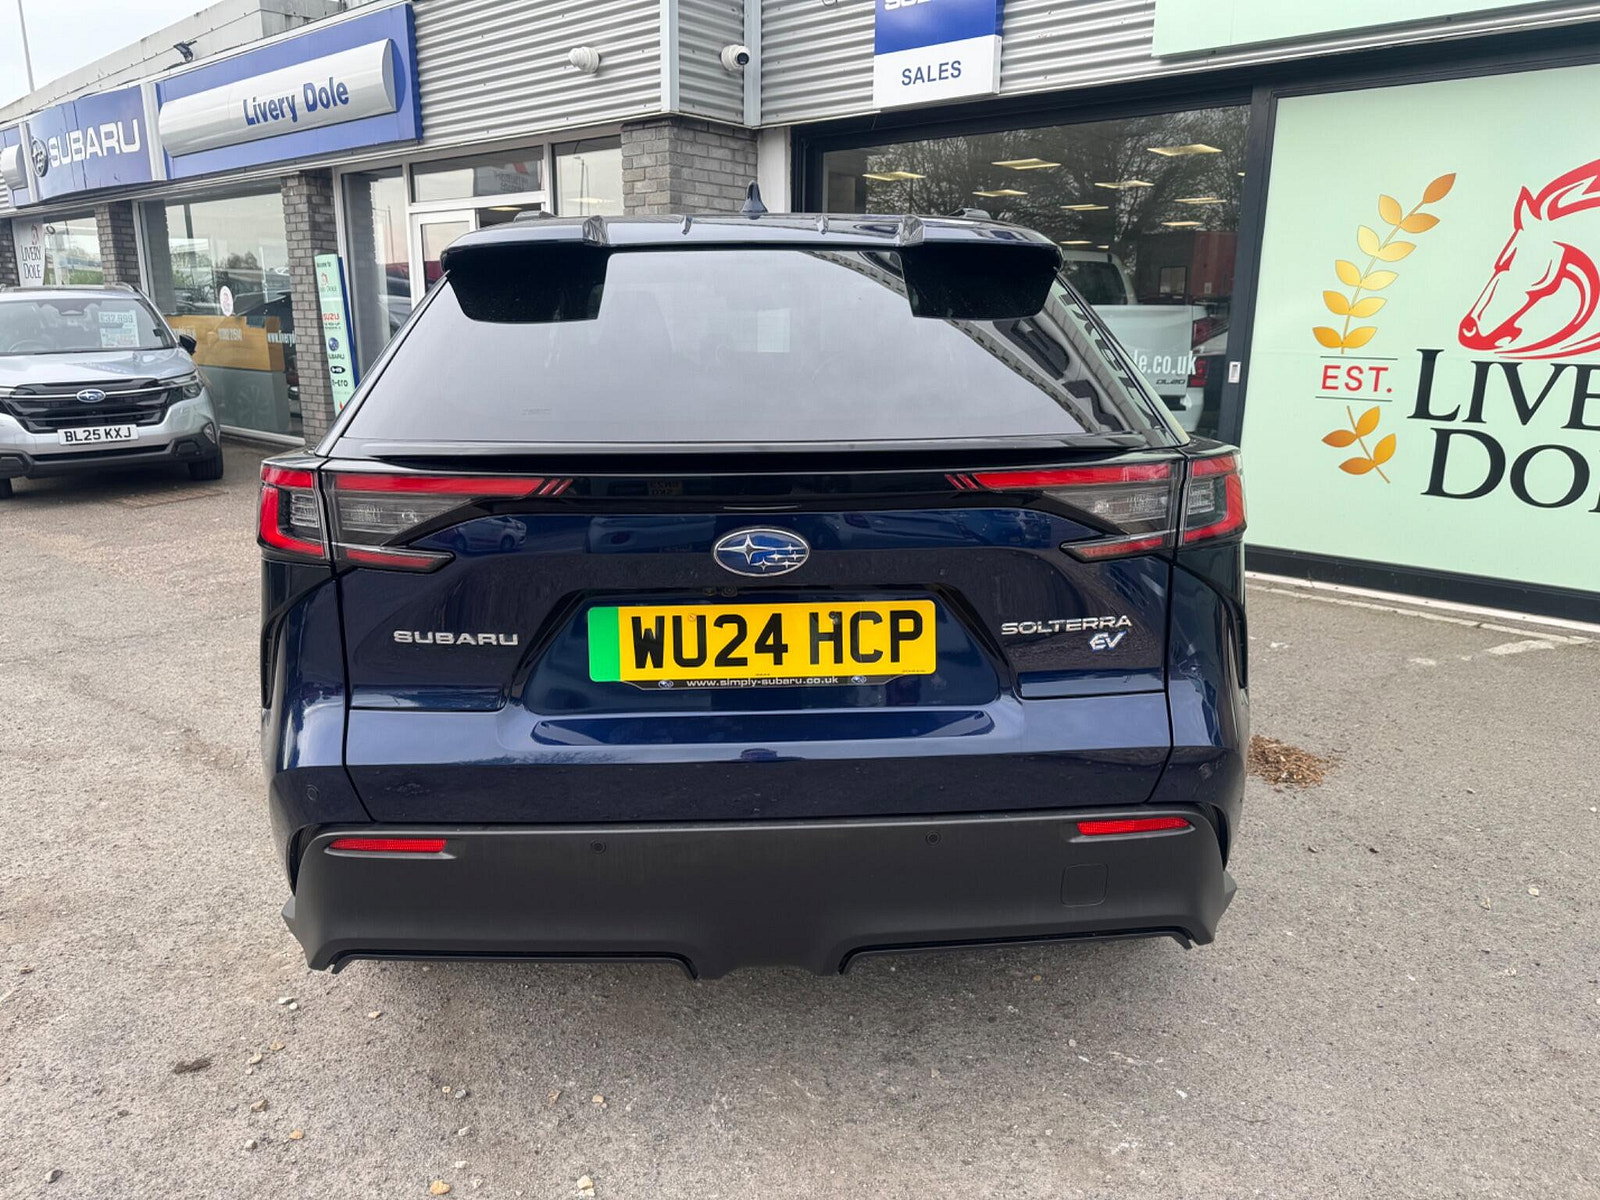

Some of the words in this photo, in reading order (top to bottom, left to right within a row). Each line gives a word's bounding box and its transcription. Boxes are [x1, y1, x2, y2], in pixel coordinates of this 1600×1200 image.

[901, 60, 961, 86] SALES
[243, 95, 298, 126] Livery
[303, 77, 349, 112] Dole
[48, 118, 140, 168] SUBARU
[23, 262, 42, 279] DOLE
[1321, 364, 1393, 394] EST.
[64, 428, 102, 443] BL25
[104, 426, 132, 440] KXJ
[1420, 427, 1600, 513] DO
[1001, 614, 1133, 635] SOLTERRA
[393, 630, 519, 646] SUBARU
[631, 612, 789, 669] WU24
[808, 609, 924, 665] HCP
[1089, 630, 1127, 651] EV
[686, 674, 839, 688] www.simply-subaru.co.uk
